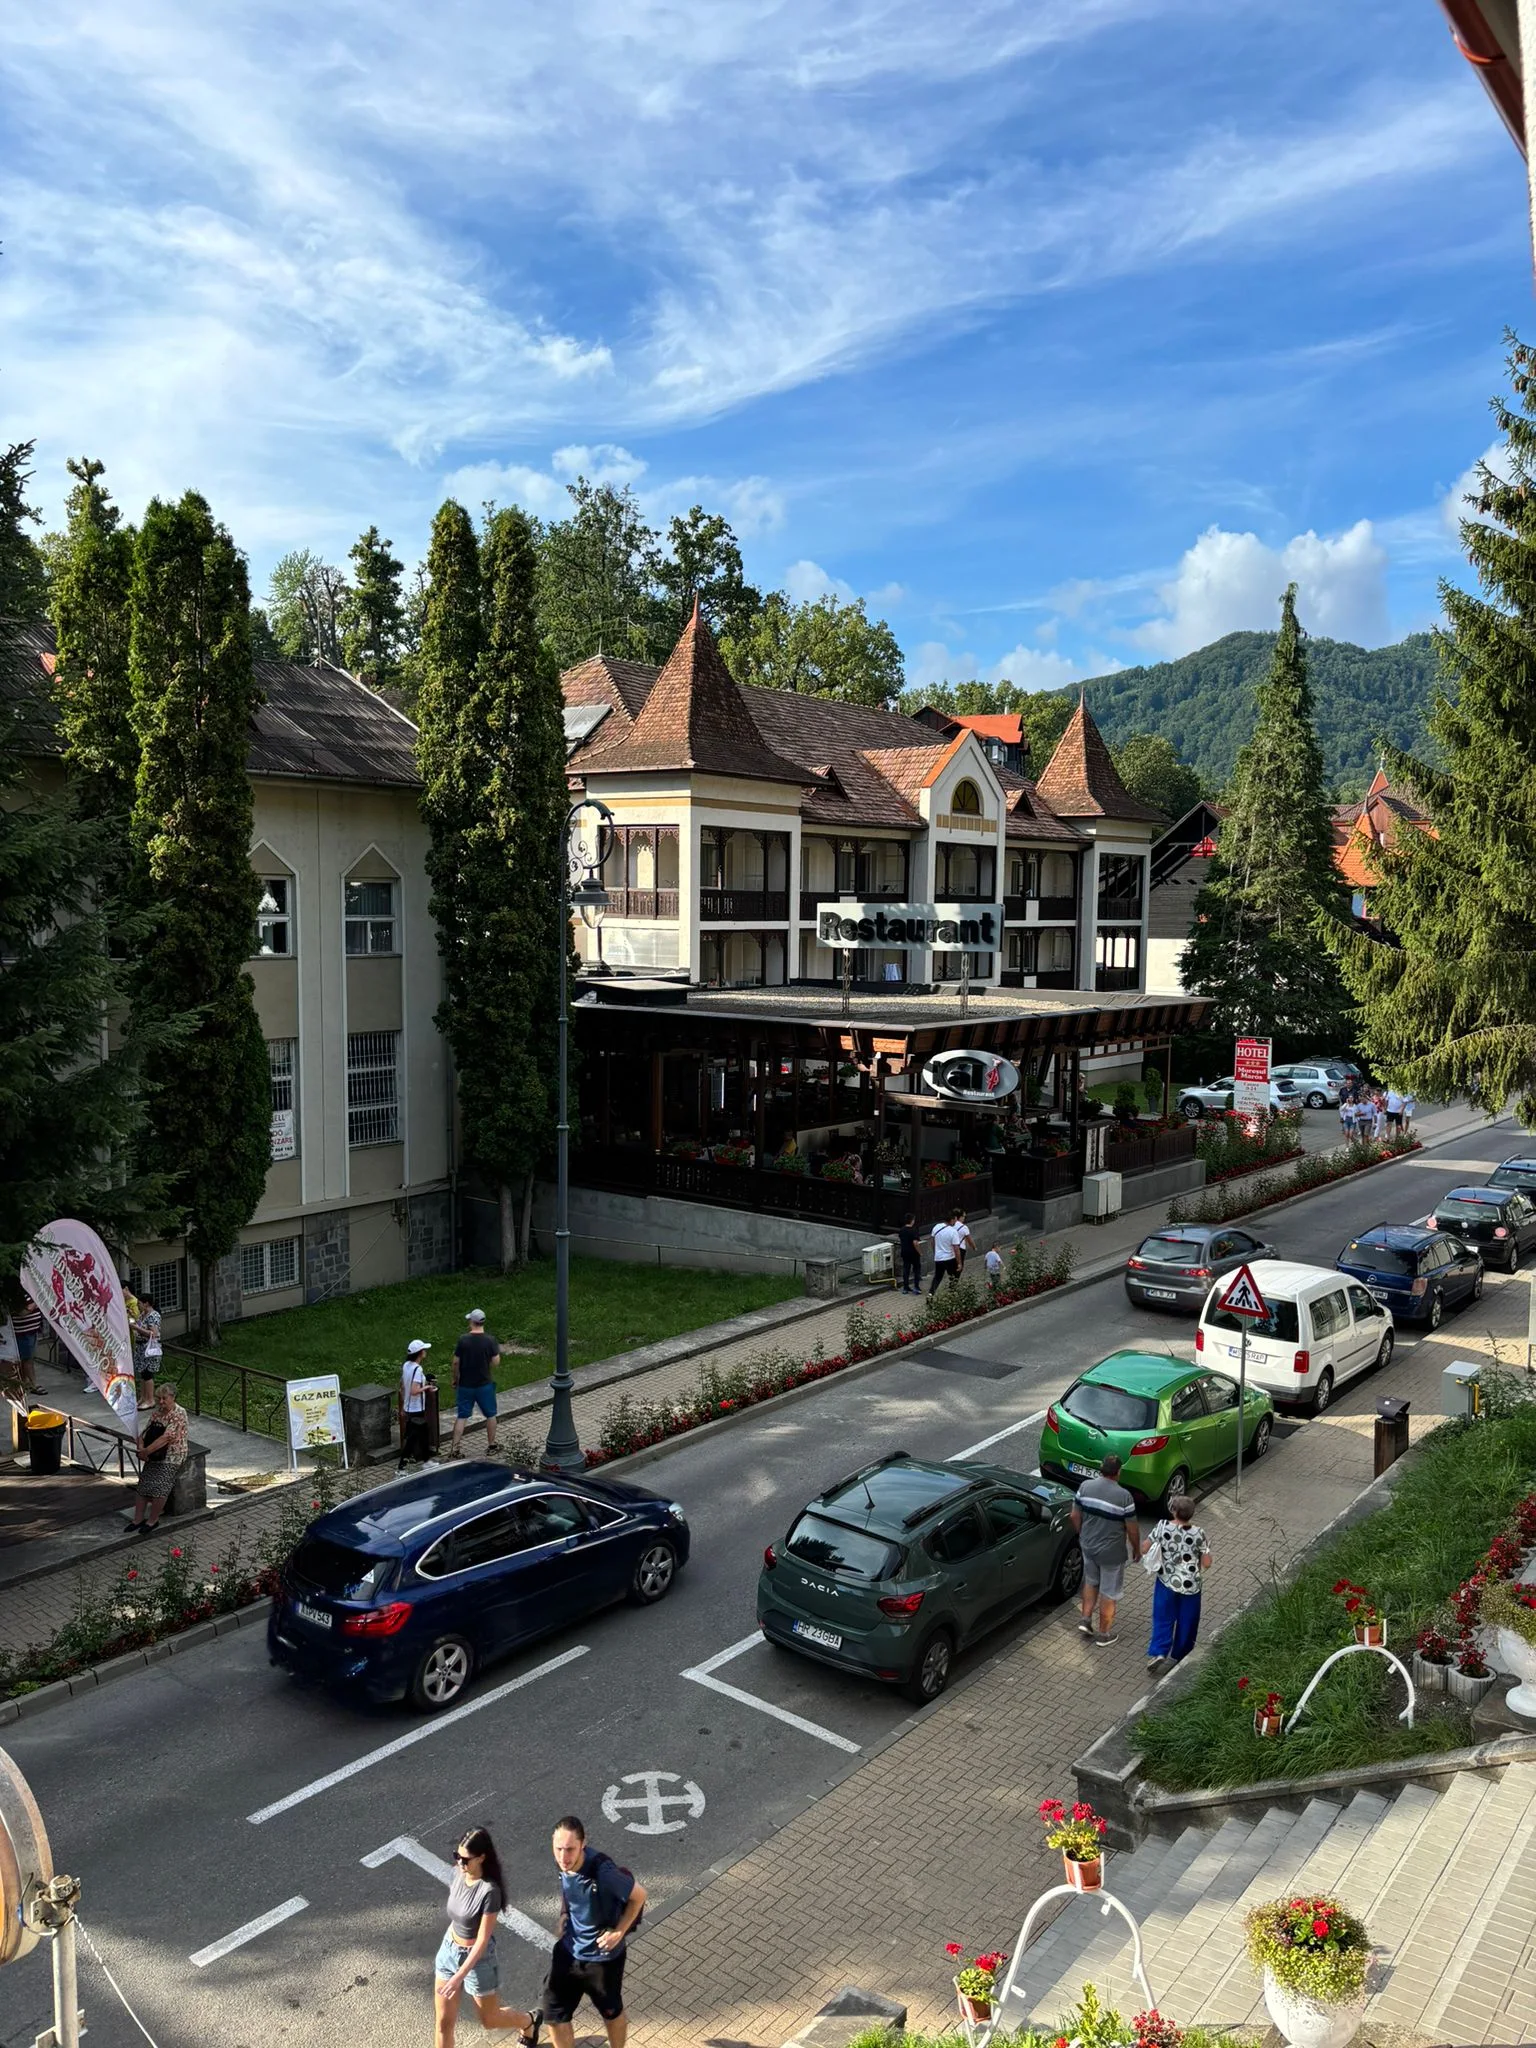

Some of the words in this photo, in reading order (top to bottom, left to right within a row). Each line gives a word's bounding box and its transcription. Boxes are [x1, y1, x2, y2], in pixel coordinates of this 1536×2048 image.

[819, 911, 995, 944] Restaurant
[1237, 1046, 1268, 1058] HOTEL
[962, 1089, 995, 1098] Restaurant
[293, 1390, 336, 1402] CAZARE
[801, 1577, 839, 1597] DACIA
[798, 1620, 810, 1634] HR
